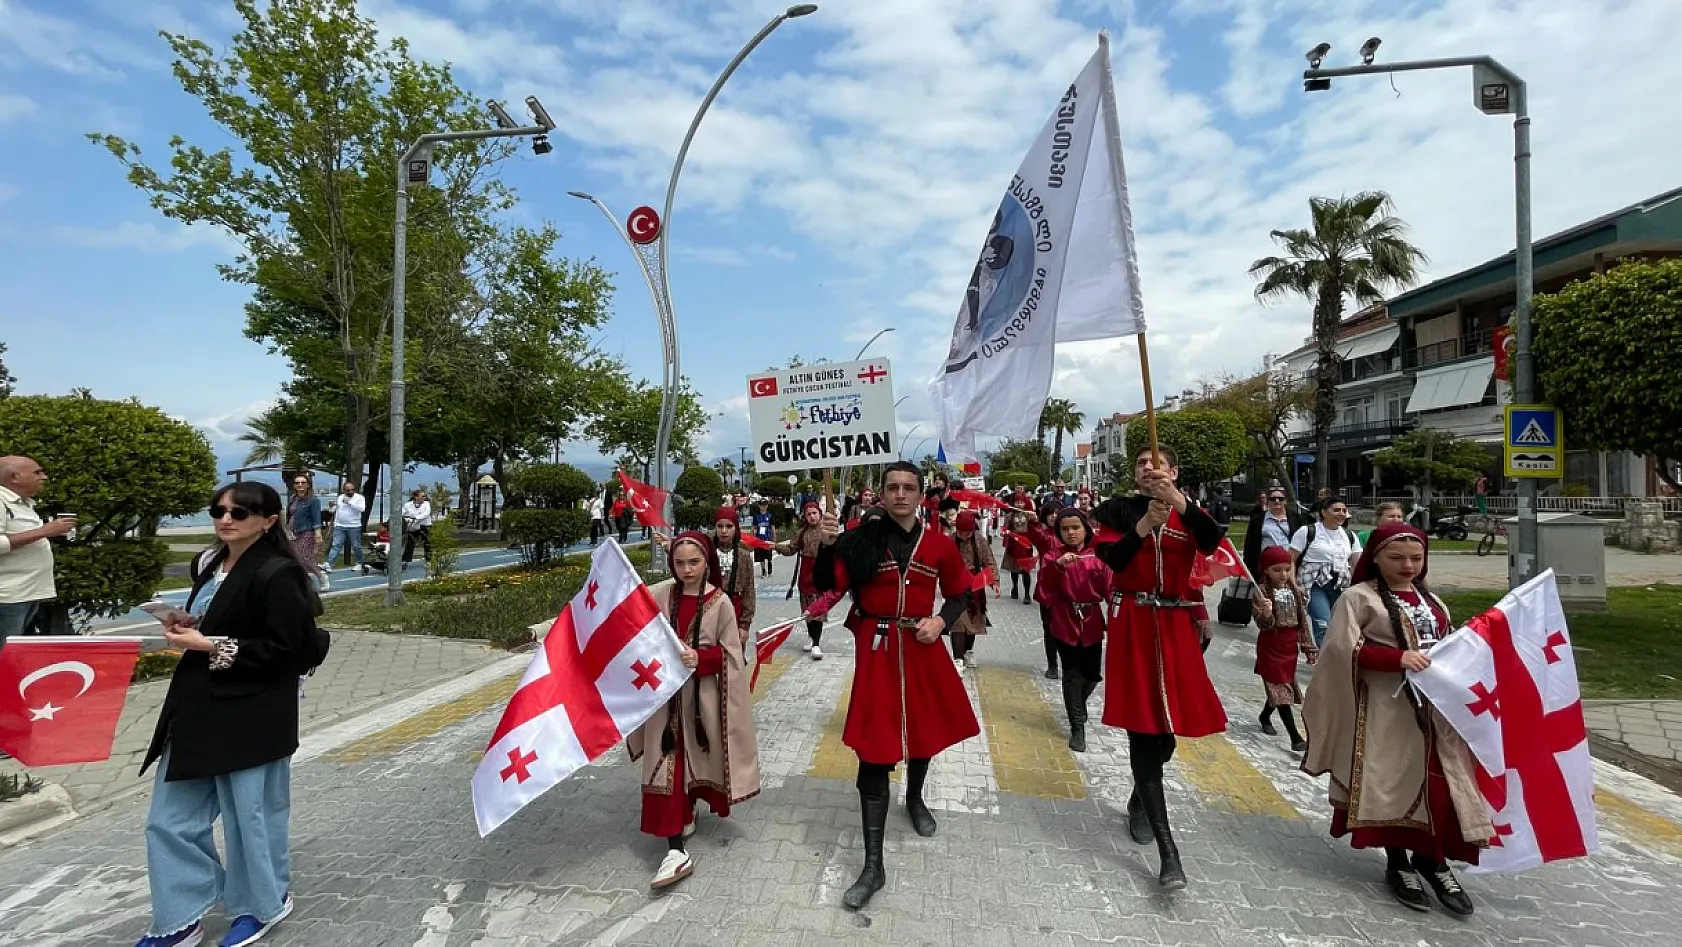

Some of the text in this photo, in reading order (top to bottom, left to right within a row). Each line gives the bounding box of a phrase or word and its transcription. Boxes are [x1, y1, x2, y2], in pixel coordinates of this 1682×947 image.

[1007, 173, 1053, 252] ნსამბლი
[789, 373, 813, 384] ALTIN
[760, 430, 892, 463] GÜRCİSTAN
